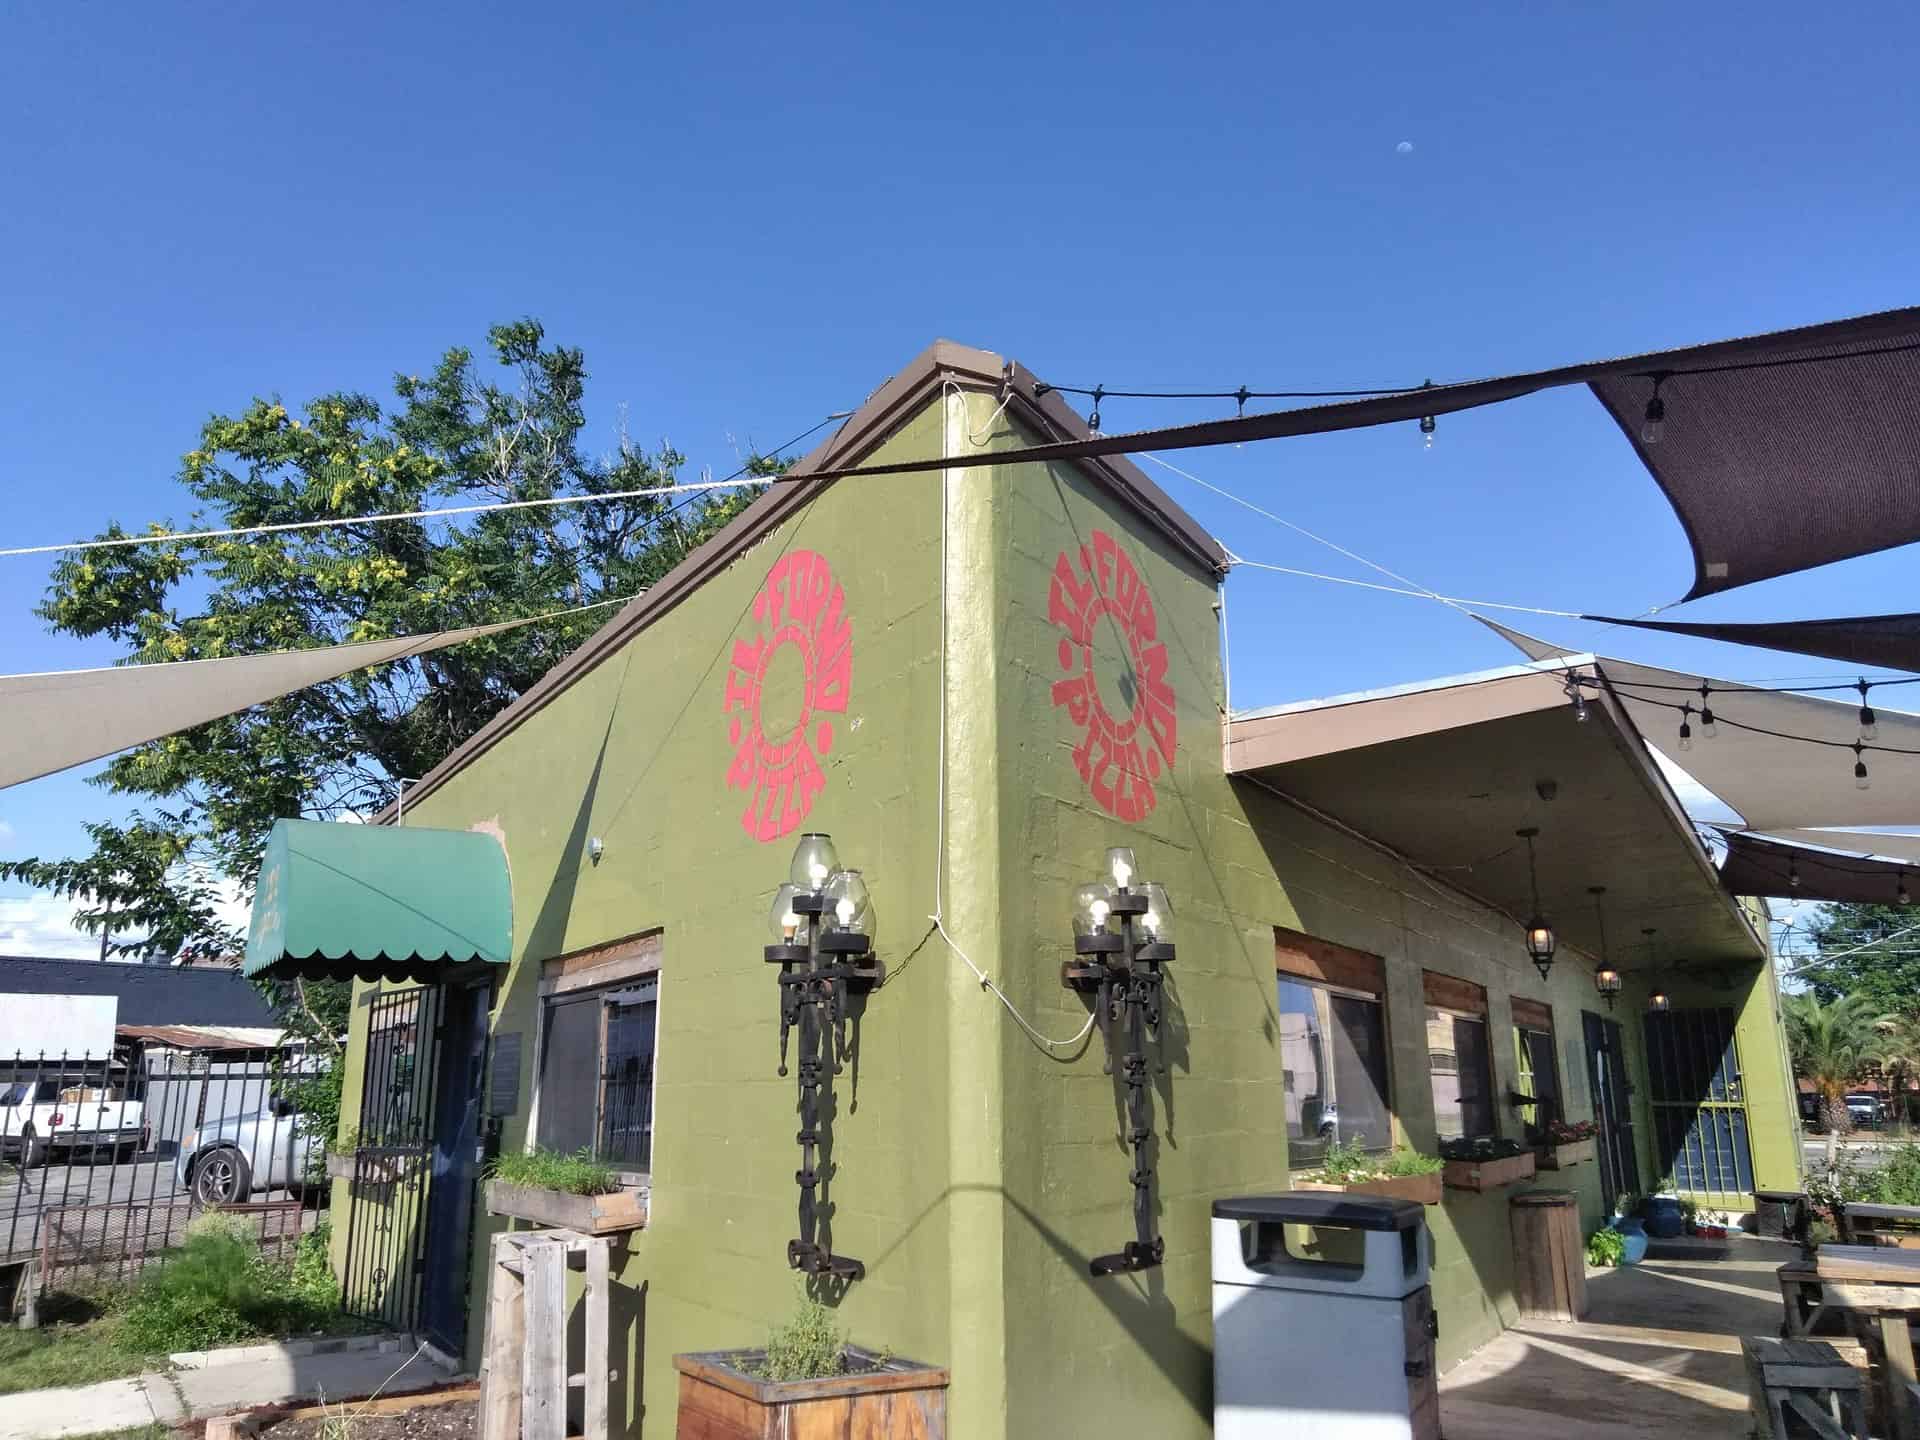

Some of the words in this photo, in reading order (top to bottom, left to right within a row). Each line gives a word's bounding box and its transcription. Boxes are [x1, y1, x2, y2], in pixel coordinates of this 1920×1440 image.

[767, 549, 853, 713] FORNO
[1048, 551, 1094, 645] IL
[1091, 529, 1177, 768] FORNO
[726, 732, 826, 842] PIZZA
[1050, 678, 1157, 822] PIZZA
